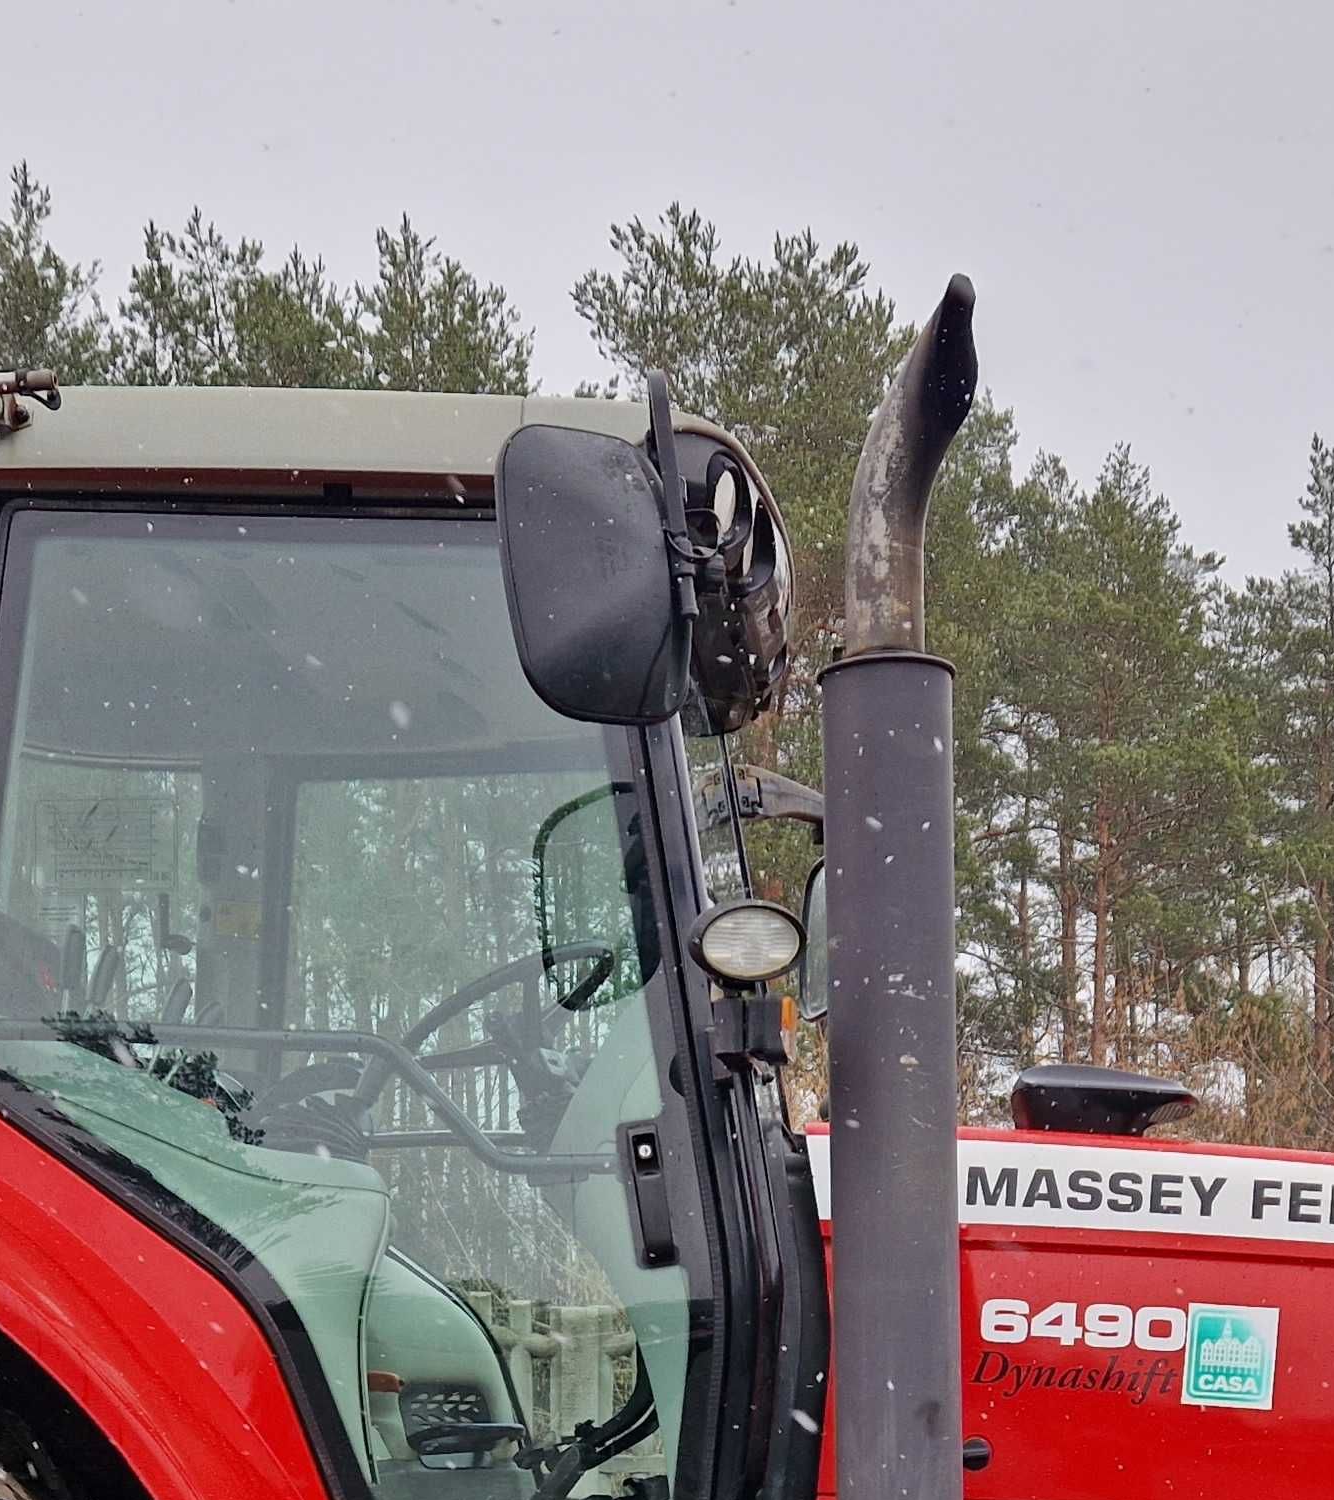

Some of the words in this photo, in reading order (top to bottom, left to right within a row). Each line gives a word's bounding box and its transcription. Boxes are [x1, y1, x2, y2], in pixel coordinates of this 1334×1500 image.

[965, 1165, 1228, 1217] MASSEY
[980, 1298, 1187, 1352] 6490
[969, 1350, 1179, 1405] Dynashift
[1197, 1374, 1260, 1394] CASA
